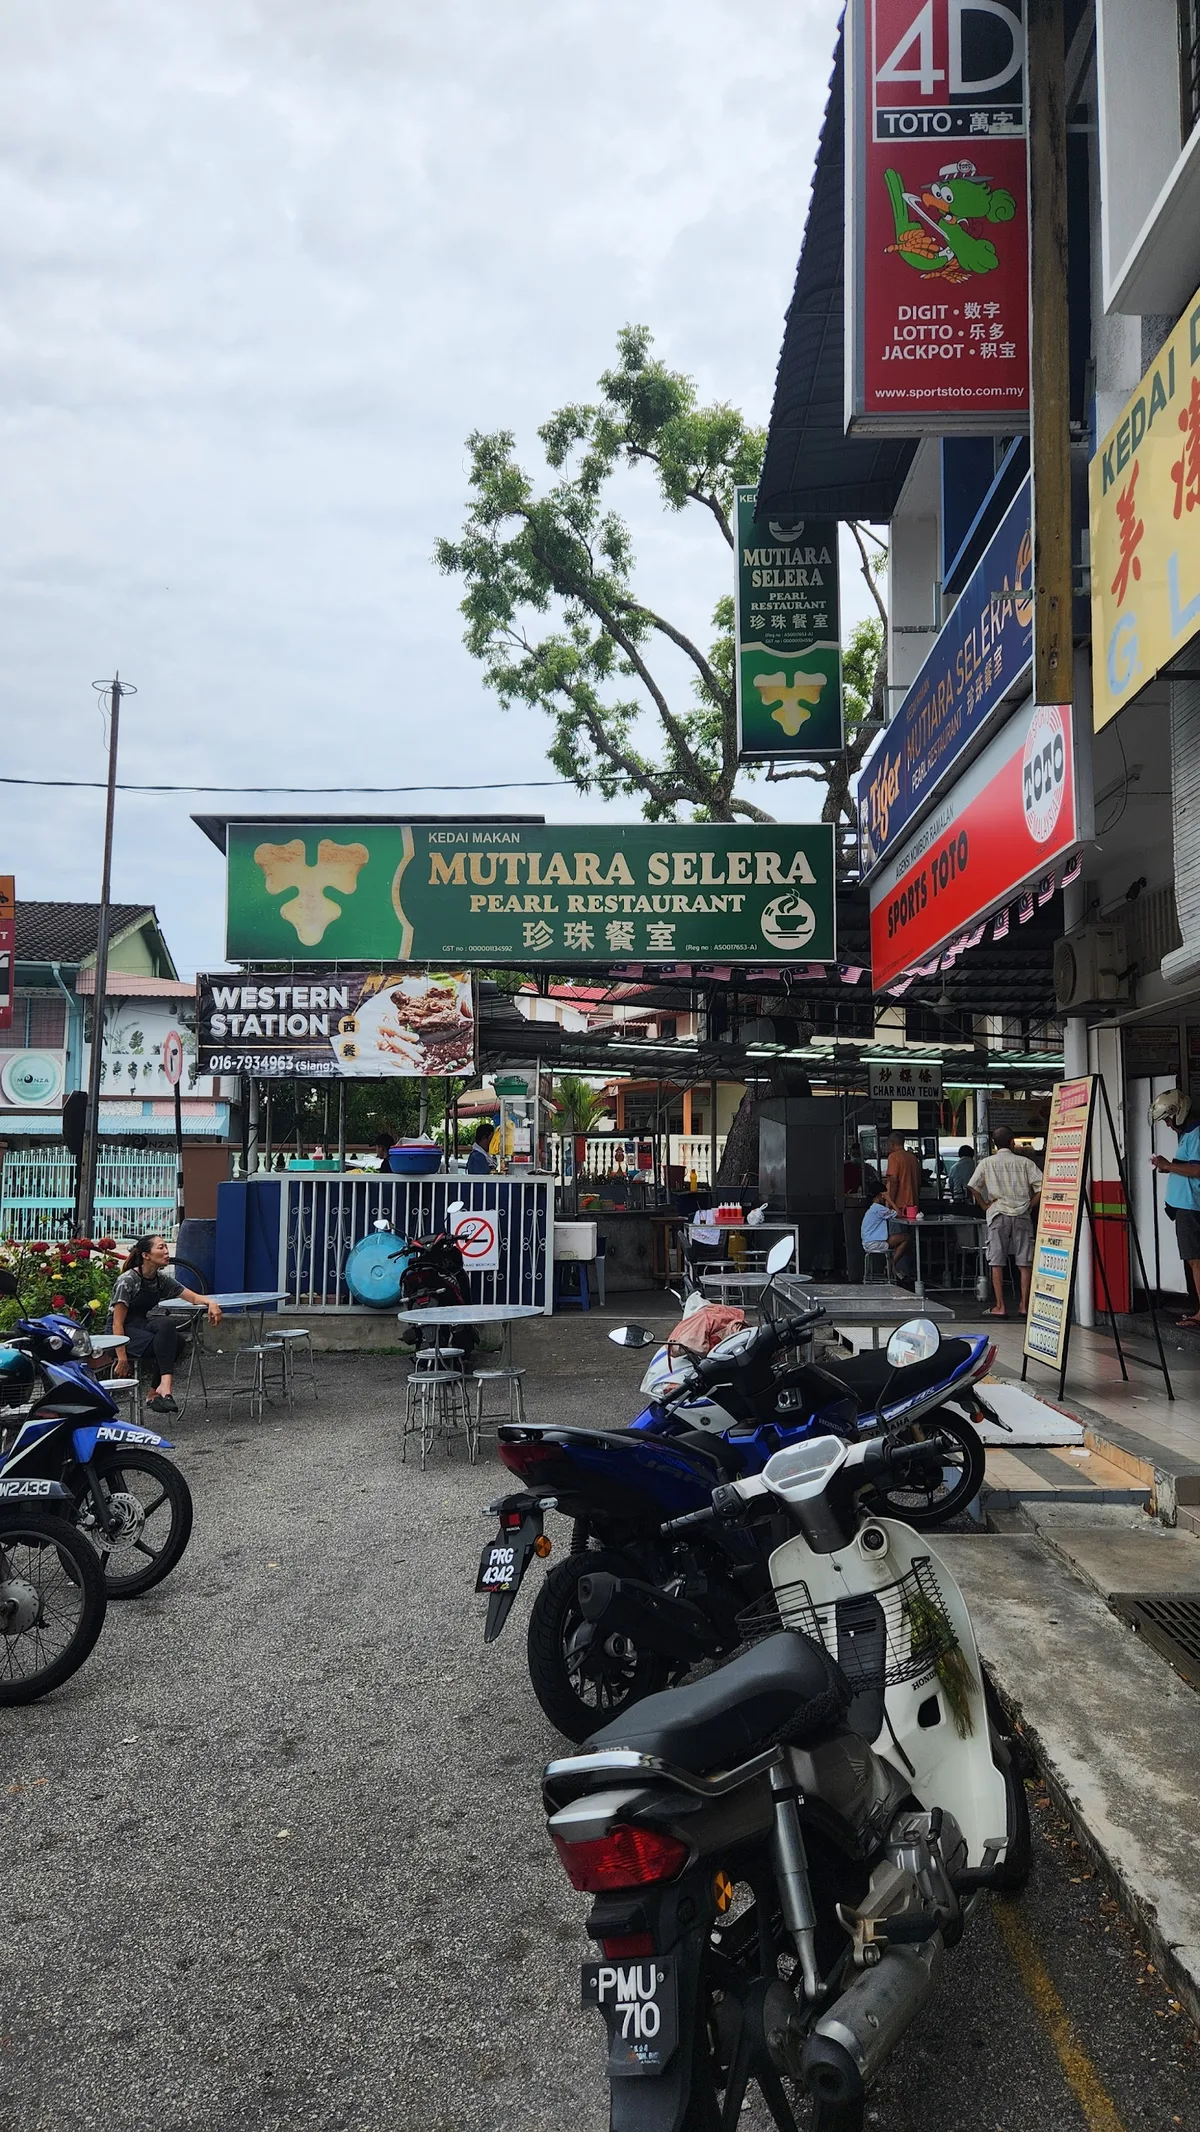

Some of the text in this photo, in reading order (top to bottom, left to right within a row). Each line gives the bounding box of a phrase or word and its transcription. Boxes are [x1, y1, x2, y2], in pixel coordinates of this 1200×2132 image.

[876, 0, 1023, 95] 4D
[884, 112, 952, 134] TOTO
[898, 301, 1001, 321] DIGIT 数字
[893, 322, 1005, 341] LOTTO 乐多
[881, 341, 1016, 360] JACKPOT 积宝
[875, 386, 1025, 399] www.sportstoto.com.my
[1102, 346, 1176, 497] KEDAI
[743, 546, 832, 567] MUTIARA
[751, 567, 824, 588] SELERA
[751, 600, 827, 611] RESTAURANT
[769, 592, 808, 601] PEARL
[749, 613, 829, 630] 珍珠餐室
[906, 574, 1013, 771] MUTIARA SELERA
[966, 643, 1003, 716] 珍珠餐室
[911, 705, 963, 794] PEARL RESTAURANT
[1024, 733, 1063, 811] TOTO
[869, 752, 902, 842] Tiger
[428, 832, 520, 843] KEDAI MAKAN
[895, 803, 955, 880] AGENSI NOMBOR RAMALAN
[428, 851, 817, 886] MUTIARA SELERA
[888, 829, 969, 939] SPORTS TOTO
[469, 894, 746, 913] PEARL RESTAURANT
[522, 920, 676, 952] 珍珠餐室
[685, 944, 700, 952] (Reg
[211, 986, 350, 1010] WESTERN
[209, 1013, 331, 1038] STATION
[209, 1055, 335, 1073] 016-7934963 (Siang)
[879, 1067, 933, 1083] 炒粿條
[873, 1085, 940, 1098] CHAR KOAY TEOW
[97, 1426, 162, 1445] PNJ 5279
[818, 1417, 844, 1433] HONDA
[868, 1416, 910, 1437] YAAHA
[489, 1547, 515, 1566] PRG
[482, 1564, 515, 1584] 4342
[911, 1669, 938, 1691] HOND
[598, 1963, 657, 2003] PMU
[615, 2000, 661, 2039] 710
